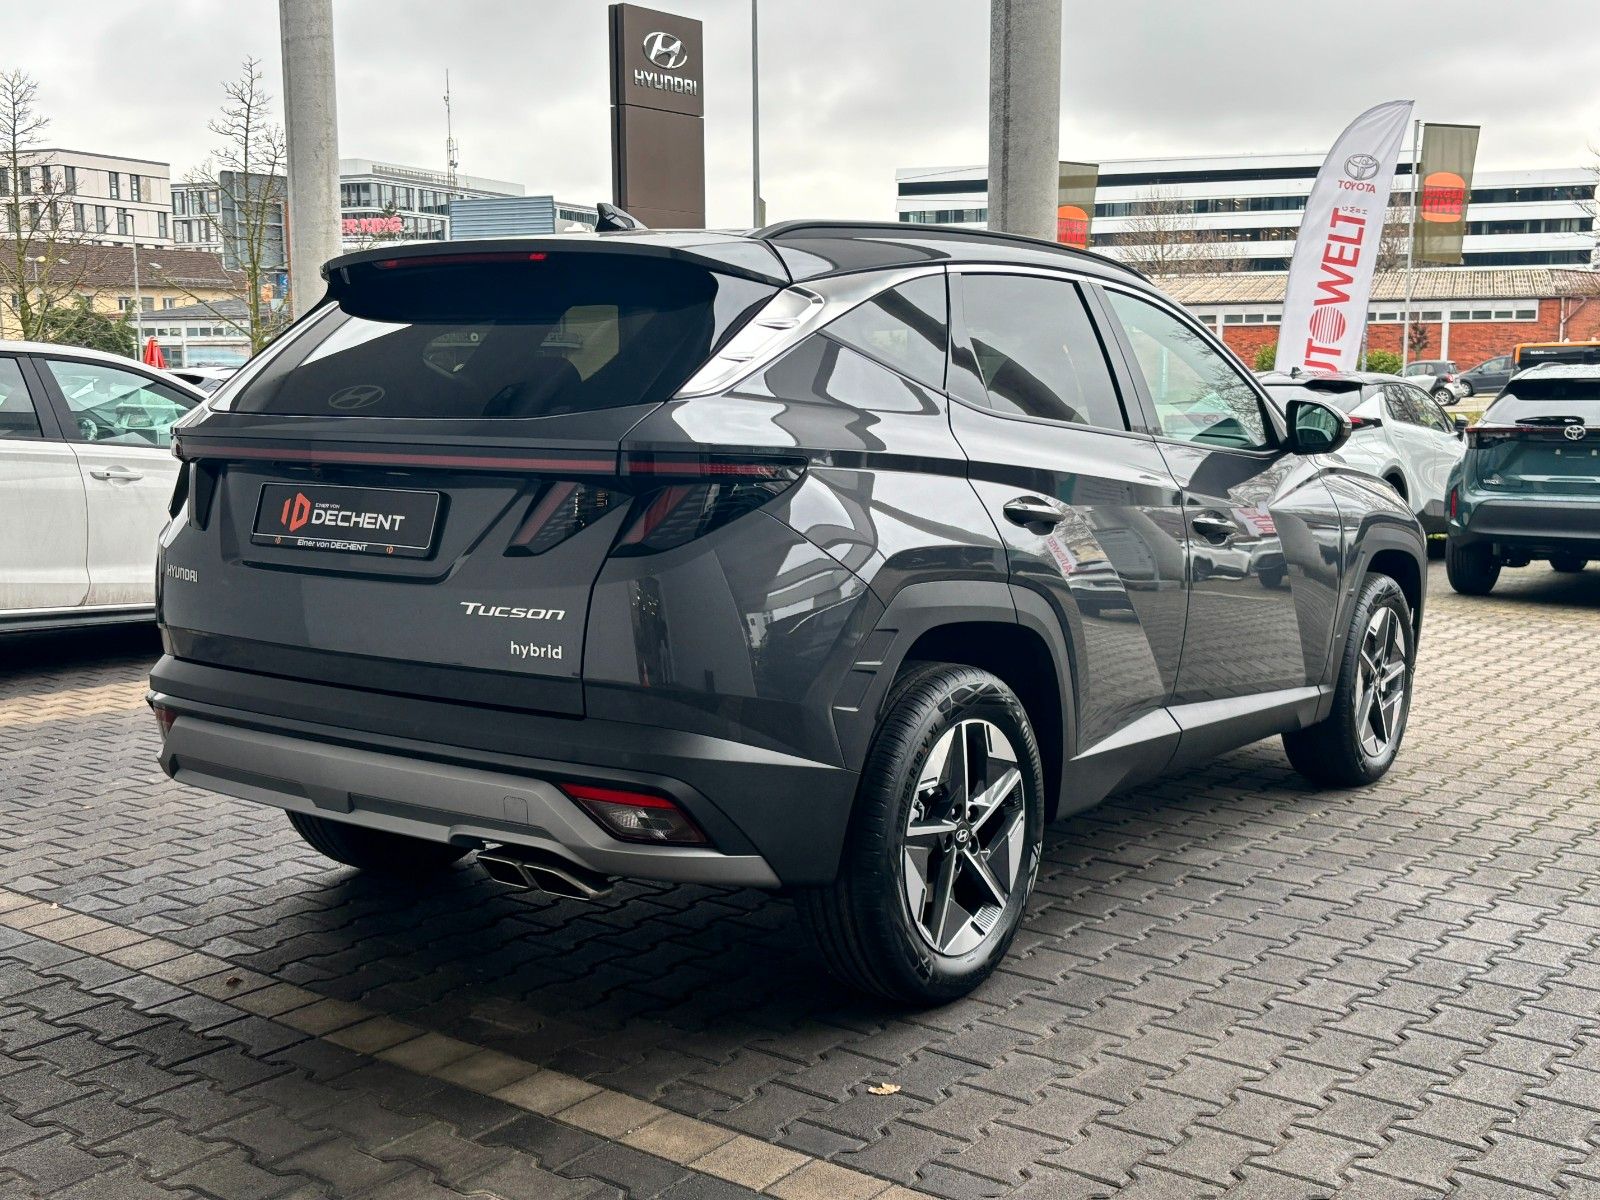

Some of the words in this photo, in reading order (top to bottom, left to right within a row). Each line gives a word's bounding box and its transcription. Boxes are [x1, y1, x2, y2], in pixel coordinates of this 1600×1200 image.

[634, 69, 697, 96] HYUNDAI
[1338, 180, 1376, 193] TOYOTA
[1304, 207, 1366, 374] UTOWELT
[311, 509, 405, 531] DECHENT
[297, 539, 315, 547] Einer
[330, 541, 367, 552] DECHENT
[166, 563, 198, 583] HYUNDAI
[510, 640, 562, 660] hybrid
